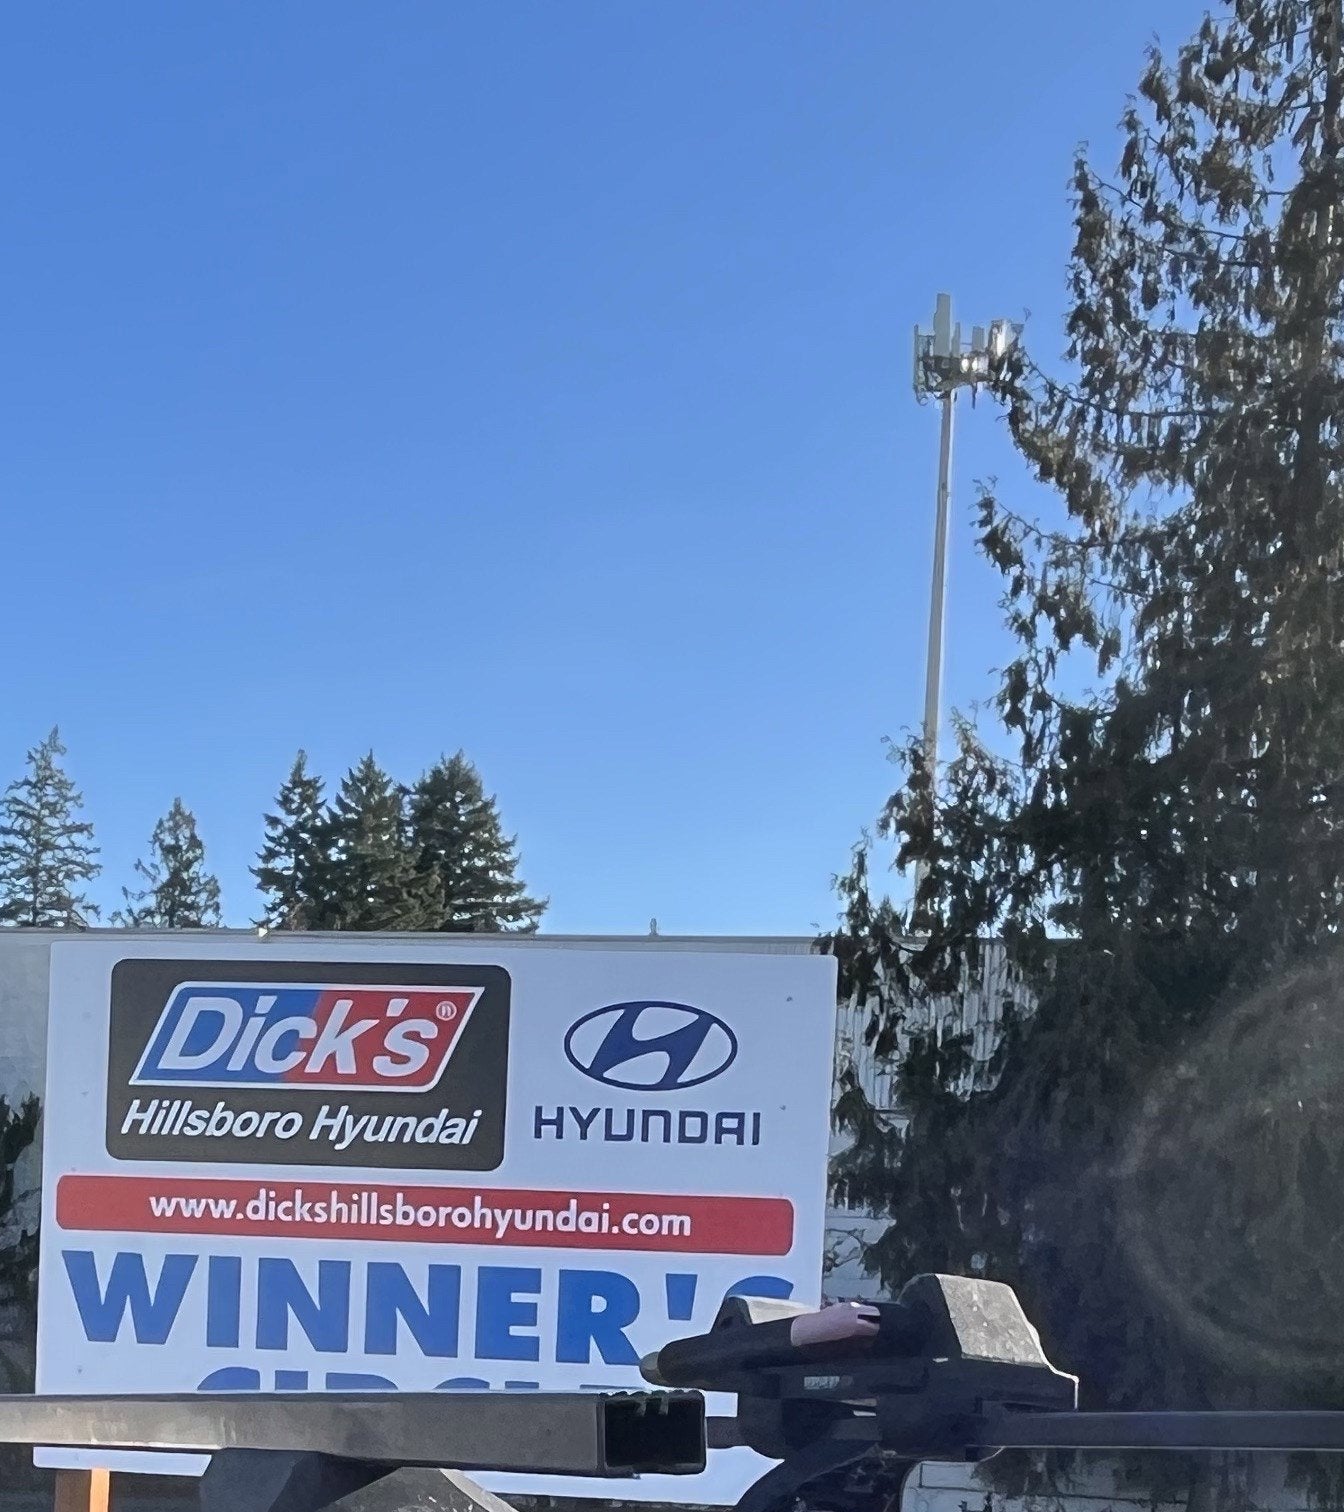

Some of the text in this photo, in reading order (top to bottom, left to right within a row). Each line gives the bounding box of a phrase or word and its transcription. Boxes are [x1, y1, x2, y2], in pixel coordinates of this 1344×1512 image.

[120, 1098, 483, 1151] Hillsboro Hyundai
[533, 1105, 762, 1146] HYUNDAI
[149, 1188, 692, 1239] www.dickshillsborohyundai.com
[60, 1249, 795, 1366] WINNER'
